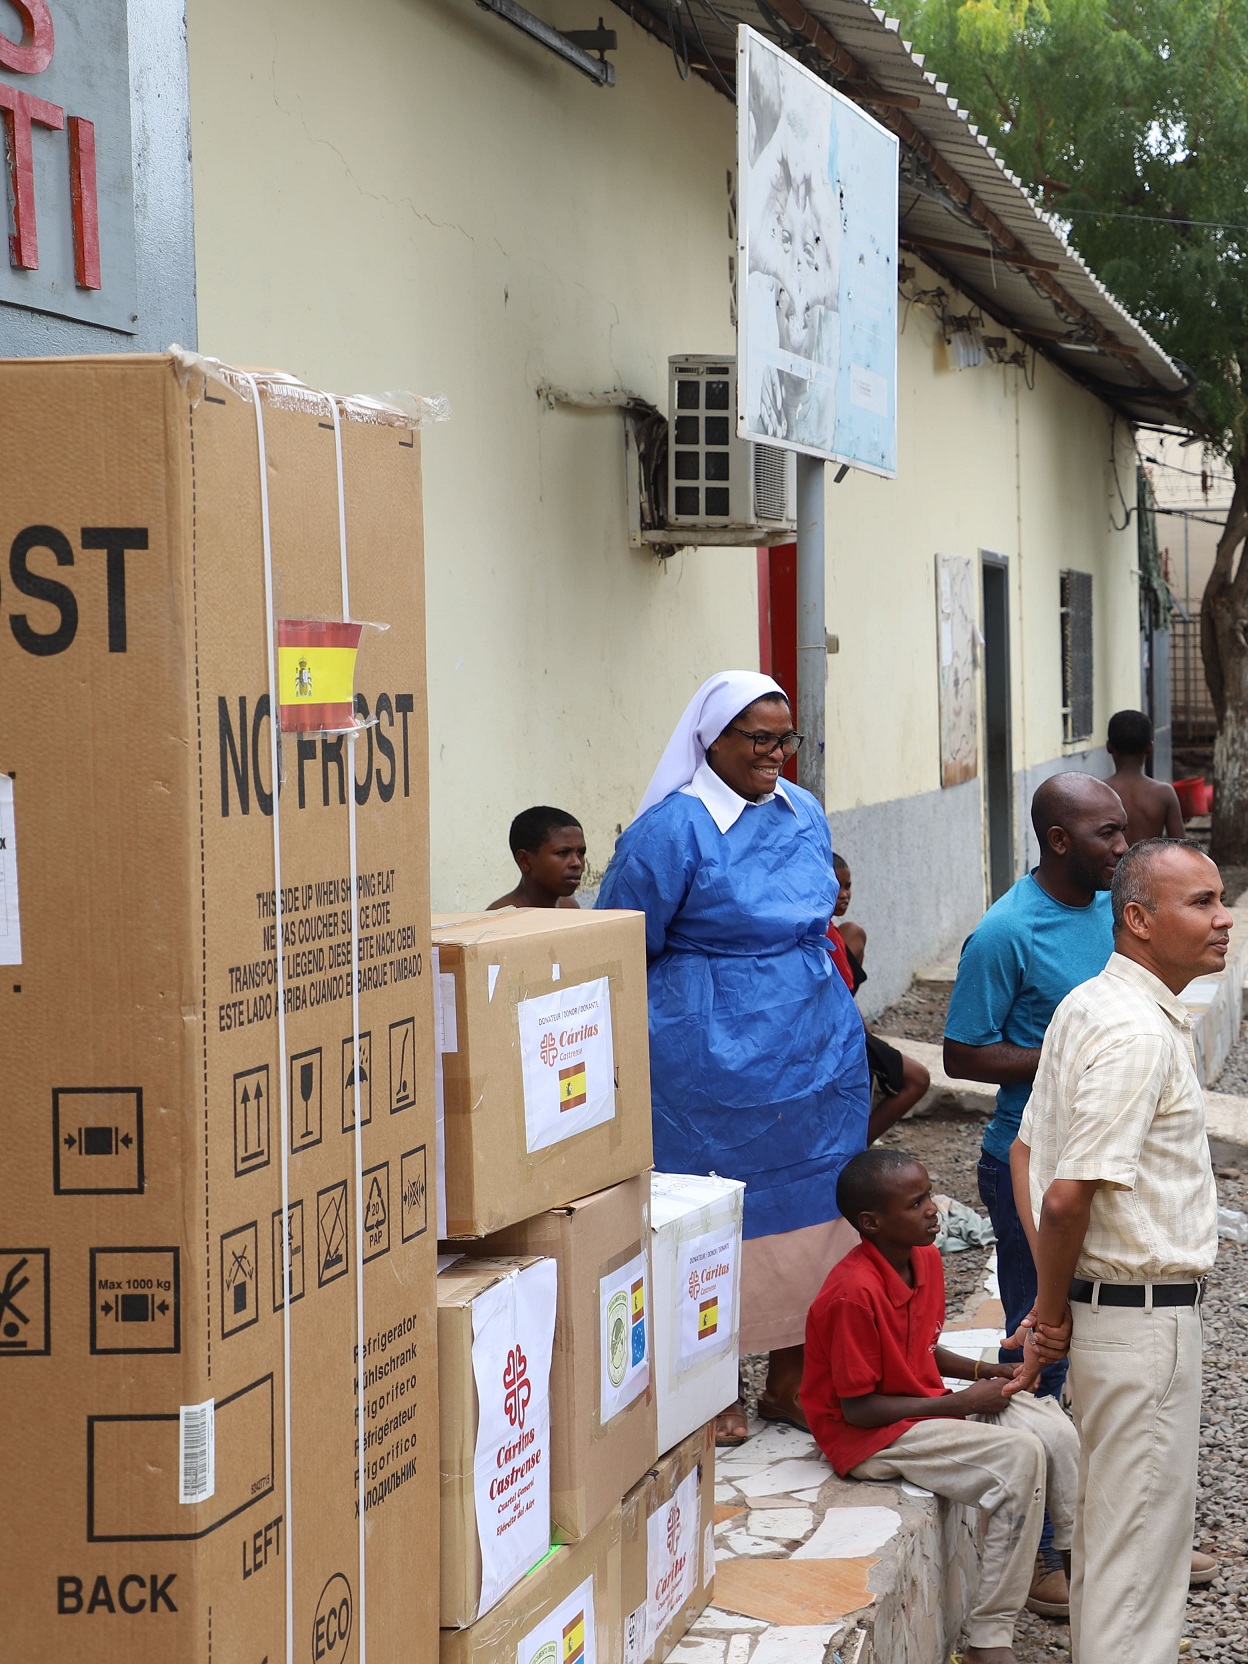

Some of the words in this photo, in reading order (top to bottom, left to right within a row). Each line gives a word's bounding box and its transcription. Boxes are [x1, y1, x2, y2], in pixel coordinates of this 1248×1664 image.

[0, 525, 148, 656] ST
[218, 694, 281, 817] NO
[256, 890, 276, 919] THIS
[280, 887, 299, 915] SIDE
[301, 884, 313, 911] UP
[315, 879, 340, 907] WHEN
[341, 873, 376, 903] SHPING
[377, 869, 395, 895] FLAT
[263, 925, 276, 951] NE
[298, 912, 339, 944] COUCHER
[341, 909, 353, 934] SU
[360, 905, 369, 930] CE
[371, 901, 390, 927] COTE
[287, 948, 327, 980] LIEGEND,
[329, 942, 352, 969] DIESE
[358, 935, 374, 961] EITE
[376, 930, 395, 957] NACH
[397, 925, 416, 951] OBEN
[218, 1001, 244, 1032] ESTE
[246, 993, 272, 1024] LADO
[309, 975, 344, 1007] CUANDO
[346, 963, 387, 997] EBARQUE
[389, 953, 422, 984] TUMBADO
[559, 1024, 599, 1048] Cáritas
[371, 1202, 379, 1217] 20
[369, 1230, 383, 1248] PAP
[98, 1279, 123, 1290] Max
[126, 1279, 153, 1289] 1000
[156, 1278, 171, 1291] kg
[701, 1263, 729, 1283] Cáritas
[496, 1428, 535, 1468] Cáritas
[489, 1449, 541, 1500] Castrense
[243, 1515, 283, 1580] LEFT
[57, 1573, 178, 1614] BACK
[316, 1598, 349, 1661] ECO
